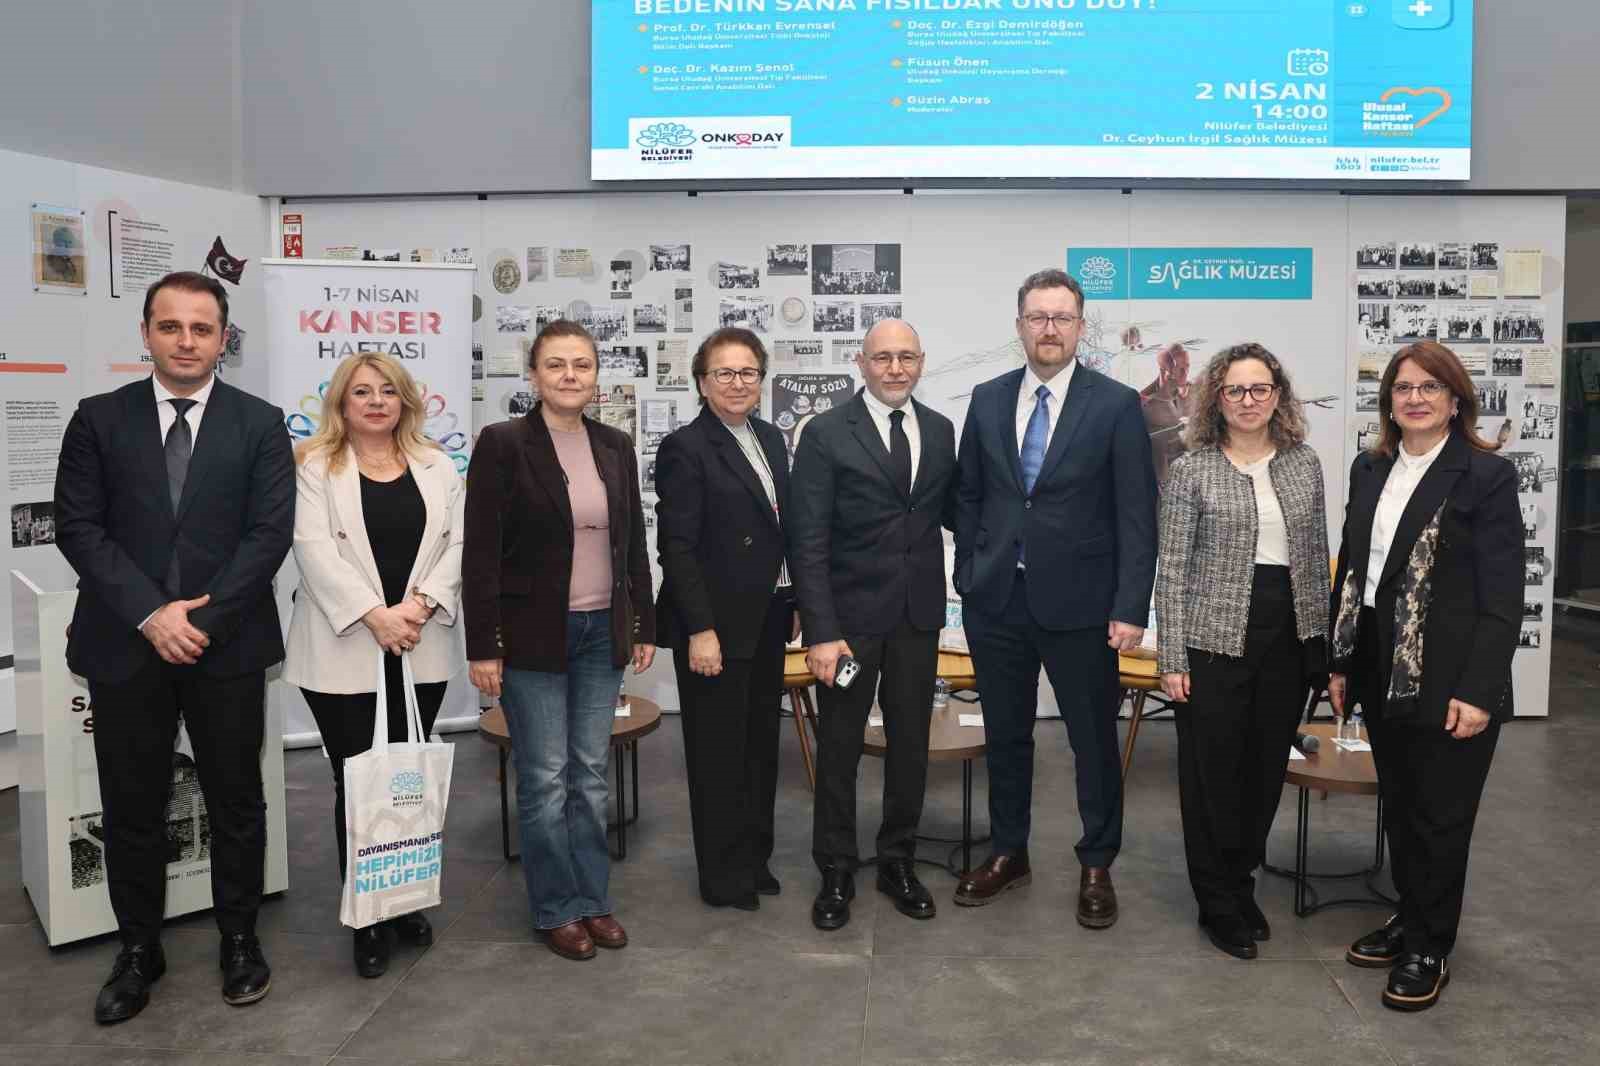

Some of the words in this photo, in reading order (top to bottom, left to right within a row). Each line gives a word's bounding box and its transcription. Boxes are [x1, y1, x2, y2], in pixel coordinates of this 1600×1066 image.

[775, 0, 858, 12] SANA
[1012, 0, 1076, 10] ONU
[653, 22, 687, 32] Prof.
[690, 22, 710, 32] Dr.
[715, 20, 772, 31] Türkkan
[941, 20, 962, 30] Dr.
[966, 19, 995, 32] Ezgi
[954, 55, 989, 67] Önen
[686, 63, 706, 73] Dr.
[1195, 82, 1214, 100] 2
[1224, 79, 1327, 100] NİSAN
[1252, 103, 1328, 119] 14:00
[1363, 102, 1406, 112] Ulusal
[1363, 111, 1413, 121] Kanser
[1204, 121, 1252, 131] Nilüfer
[1256, 121, 1328, 132] Belediyesi
[1103, 134, 1122, 143] Dr.
[1127, 134, 1185, 145] Ceyhun
[1224, 134, 1270, 145] Sağlık
[1274, 134, 1328, 144] Müzesi
[641, 147, 693, 156] NİLÜFER
[1147, 260, 1223, 289] SAĞLIK
[1229, 260, 1297, 280] MÜZESİ
[323, 287, 351, 303] 1-7
[357, 285, 420, 303] NİSAN
[299, 310, 443, 335] KANSER
[318, 341, 426, 359] HAFTASI
[779, 378, 817, 395] ATALAR
[355, 862, 440, 894] NİLÜFER
